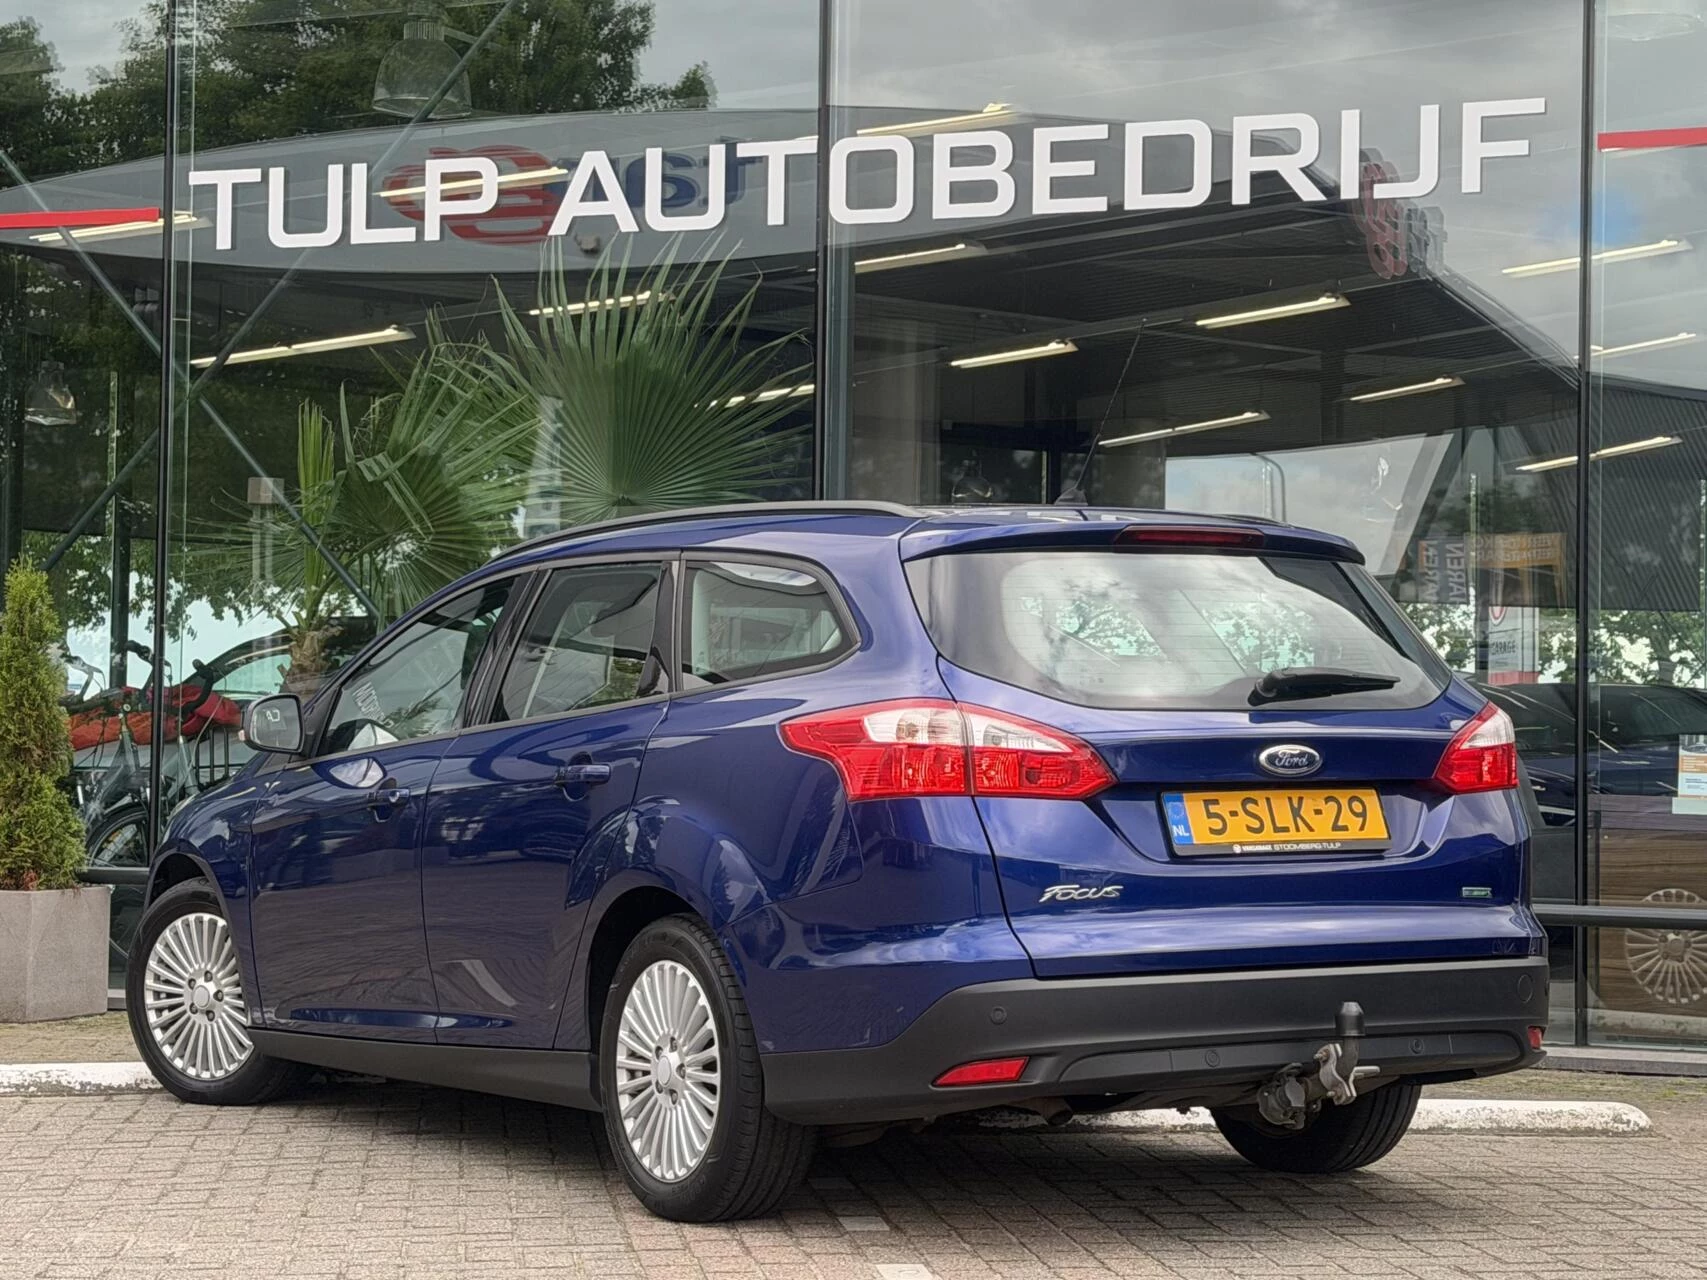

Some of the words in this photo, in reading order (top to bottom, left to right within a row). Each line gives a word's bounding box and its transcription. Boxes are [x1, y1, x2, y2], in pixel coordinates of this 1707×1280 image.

[188, 156, 498, 250] TULP
[547, 97, 1546, 236] AUTOBEDRIJF
[1275, 749, 1309, 767] Ford
[1202, 795, 1367, 836] 5-SLK-29
[1173, 824, 1190, 837] NL
